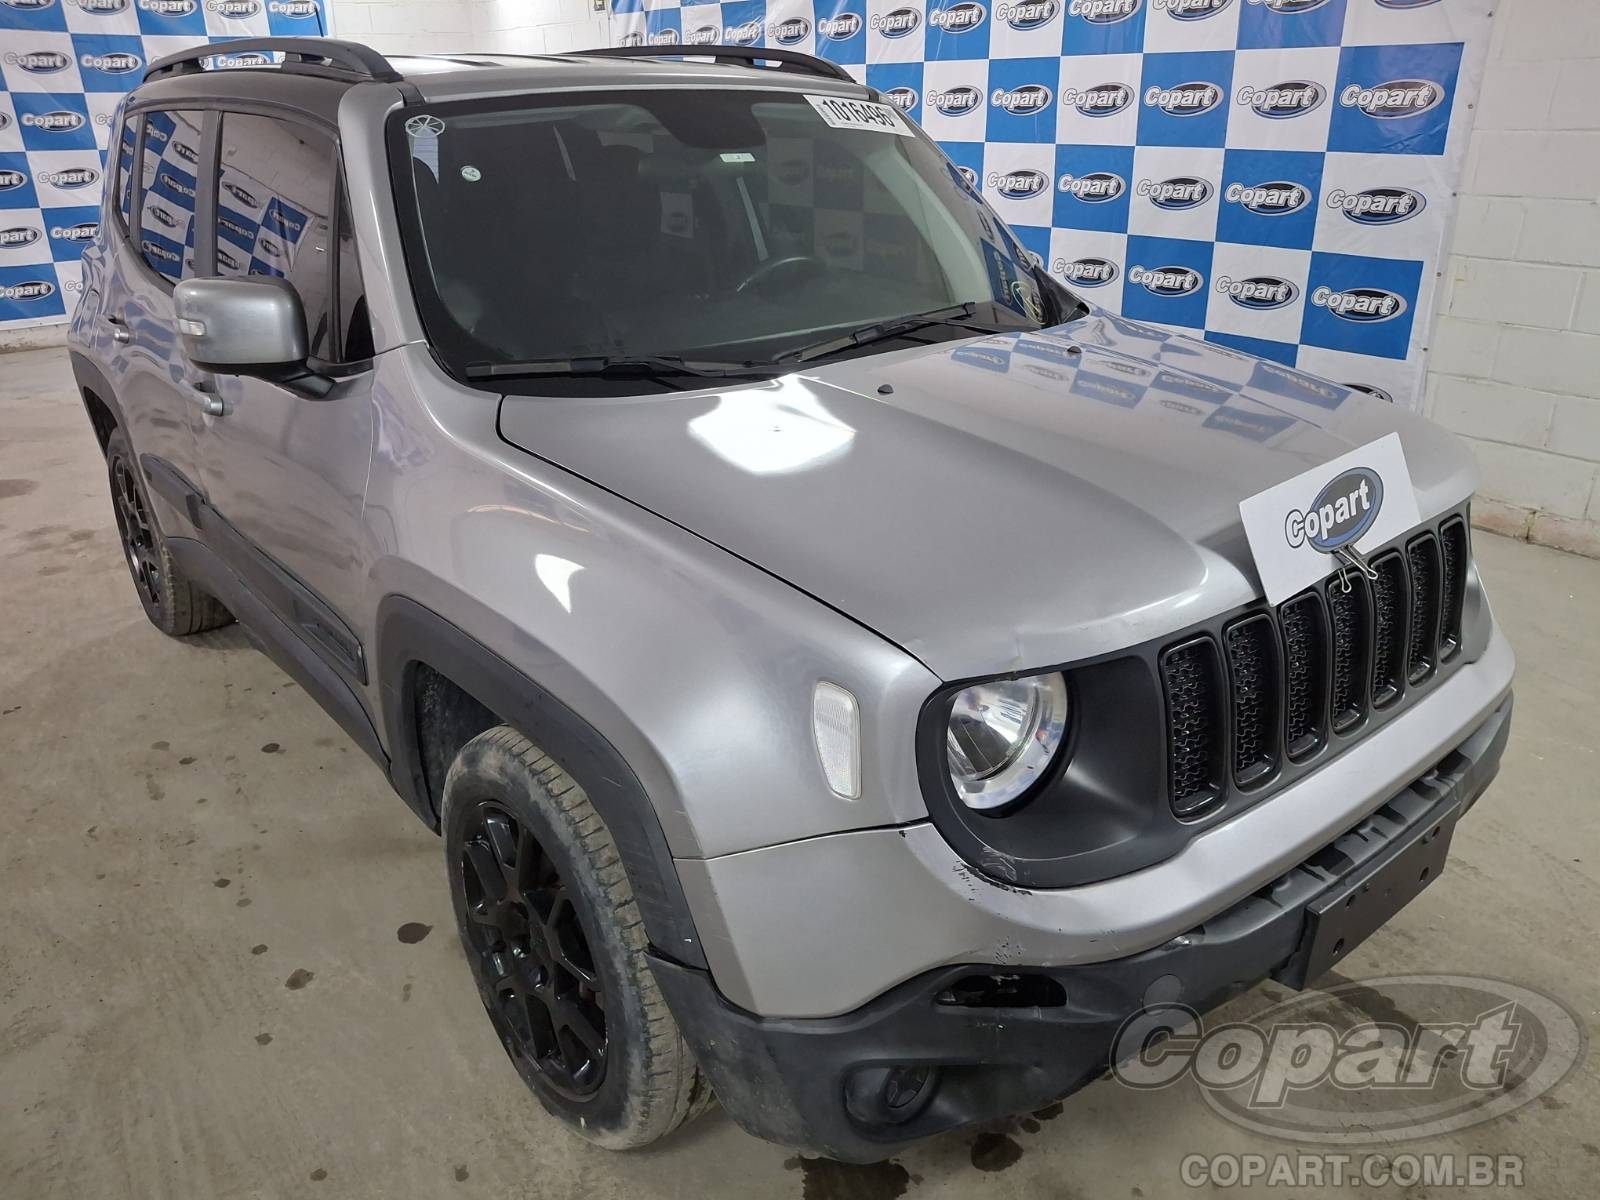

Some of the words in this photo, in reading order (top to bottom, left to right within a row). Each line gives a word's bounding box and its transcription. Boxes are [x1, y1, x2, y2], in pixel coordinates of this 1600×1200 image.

[140, 0, 191, 14] Copart
[207, 1, 255, 14] Copart
[269, 1, 314, 14] Copart
[929, 7, 980, 29] Copart
[996, 1, 1050, 24] Copart
[1069, 0, 1133, 19] Copart
[724, 24, 758, 44] Copart
[767, 20, 807, 44] Copart
[818, 16, 859, 39] Copart
[870, 12, 915, 36] Copart
[4, 52, 63, 69] Copart
[81, 54, 135, 70] Copart
[217, 56, 264, 67] Copart
[926, 90, 976, 111] Copart
[991, 89, 1045, 110] Copart
[1063, 88, 1127, 110] Copart
[1144, 85, 1217, 110] Copart
[1236, 86, 1316, 110] Copart
[1340, 84, 1435, 110] Copart
[22, 113, 79, 128] Copart
[822, 99, 896, 128] 1016496
[38, 170, 92, 186] Copart
[987, 171, 1042, 192] Copart
[1059, 174, 1119, 197] Copart
[1136, 179, 1205, 202] Copart
[1224, 183, 1304, 208] Copart
[1326, 189, 1416, 215] Copart
[51, 226, 100, 241] Copar
[1053, 258, 1112, 283] Copart
[1129, 264, 1196, 290] Copart
[1215, 275, 1290, 302] Copart
[1312, 286, 1395, 315] Copart
[1285, 479, 1371, 549] Copart
